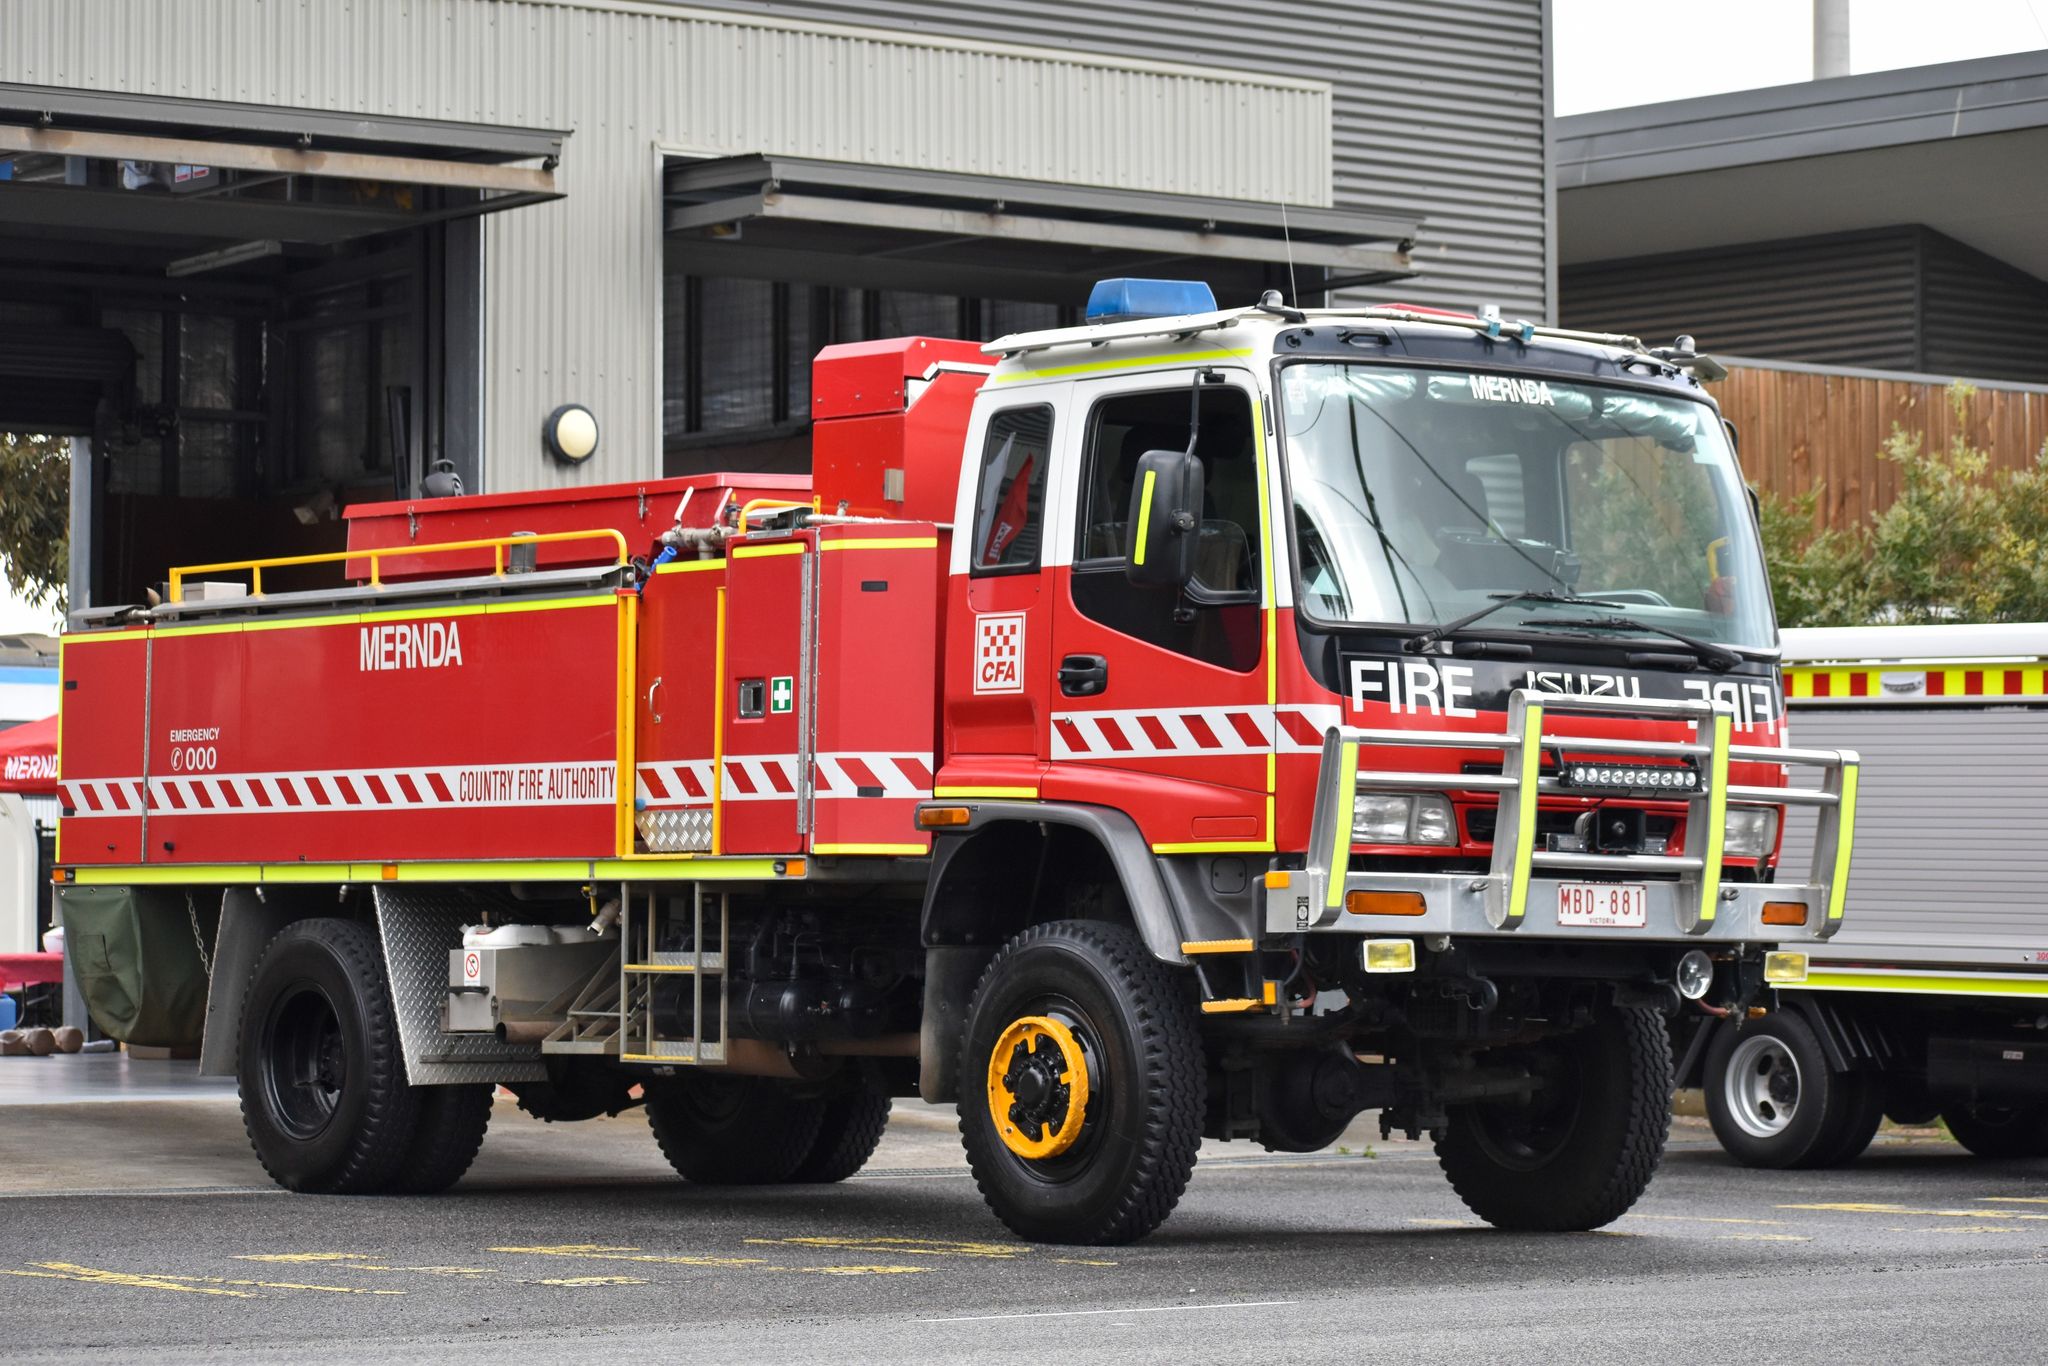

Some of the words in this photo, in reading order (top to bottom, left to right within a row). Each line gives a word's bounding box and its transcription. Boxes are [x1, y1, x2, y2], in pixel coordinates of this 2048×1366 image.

[1469, 375, 1555, 406] MERNDA
[360, 621, 463, 671] MERNDA
[982, 660, 1017, 683] CFA
[1526, 670, 1640, 698] ISUZU
[1350, 660, 1477, 718] FIRE
[170, 727, 220, 742] EMERGENCY
[185, 746, 217, 771] 000
[459, 770, 514, 802] COUNTRY
[518, 769, 544, 800] FIRE
[548, 766, 615, 799] AUTHORITY
